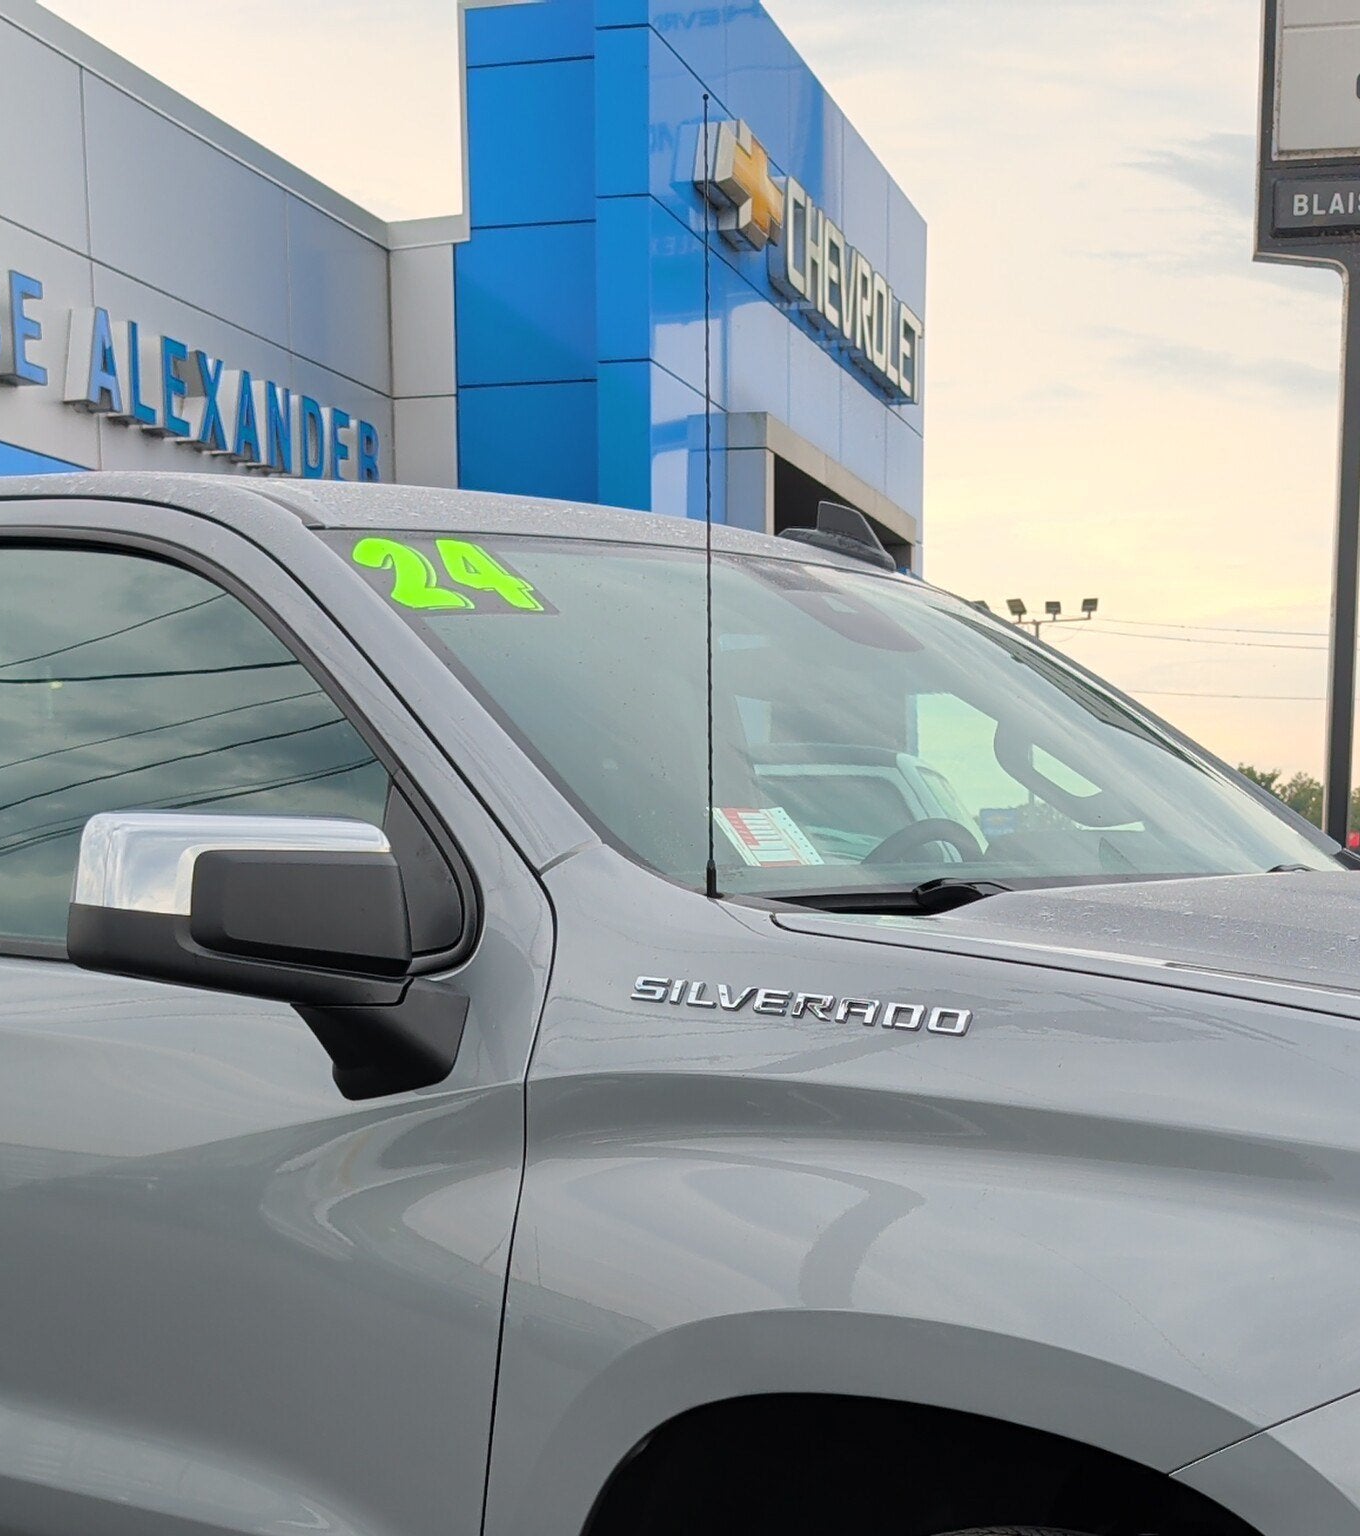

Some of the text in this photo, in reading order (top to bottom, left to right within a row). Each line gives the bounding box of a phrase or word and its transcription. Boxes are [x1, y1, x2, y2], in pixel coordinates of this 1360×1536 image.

[786, 175, 924, 405] CHEVROLET
[86, 306, 381, 483] ALEXANDER
[352, 537, 544, 611] 24
[630, 975, 973, 1037] SILVERADO
